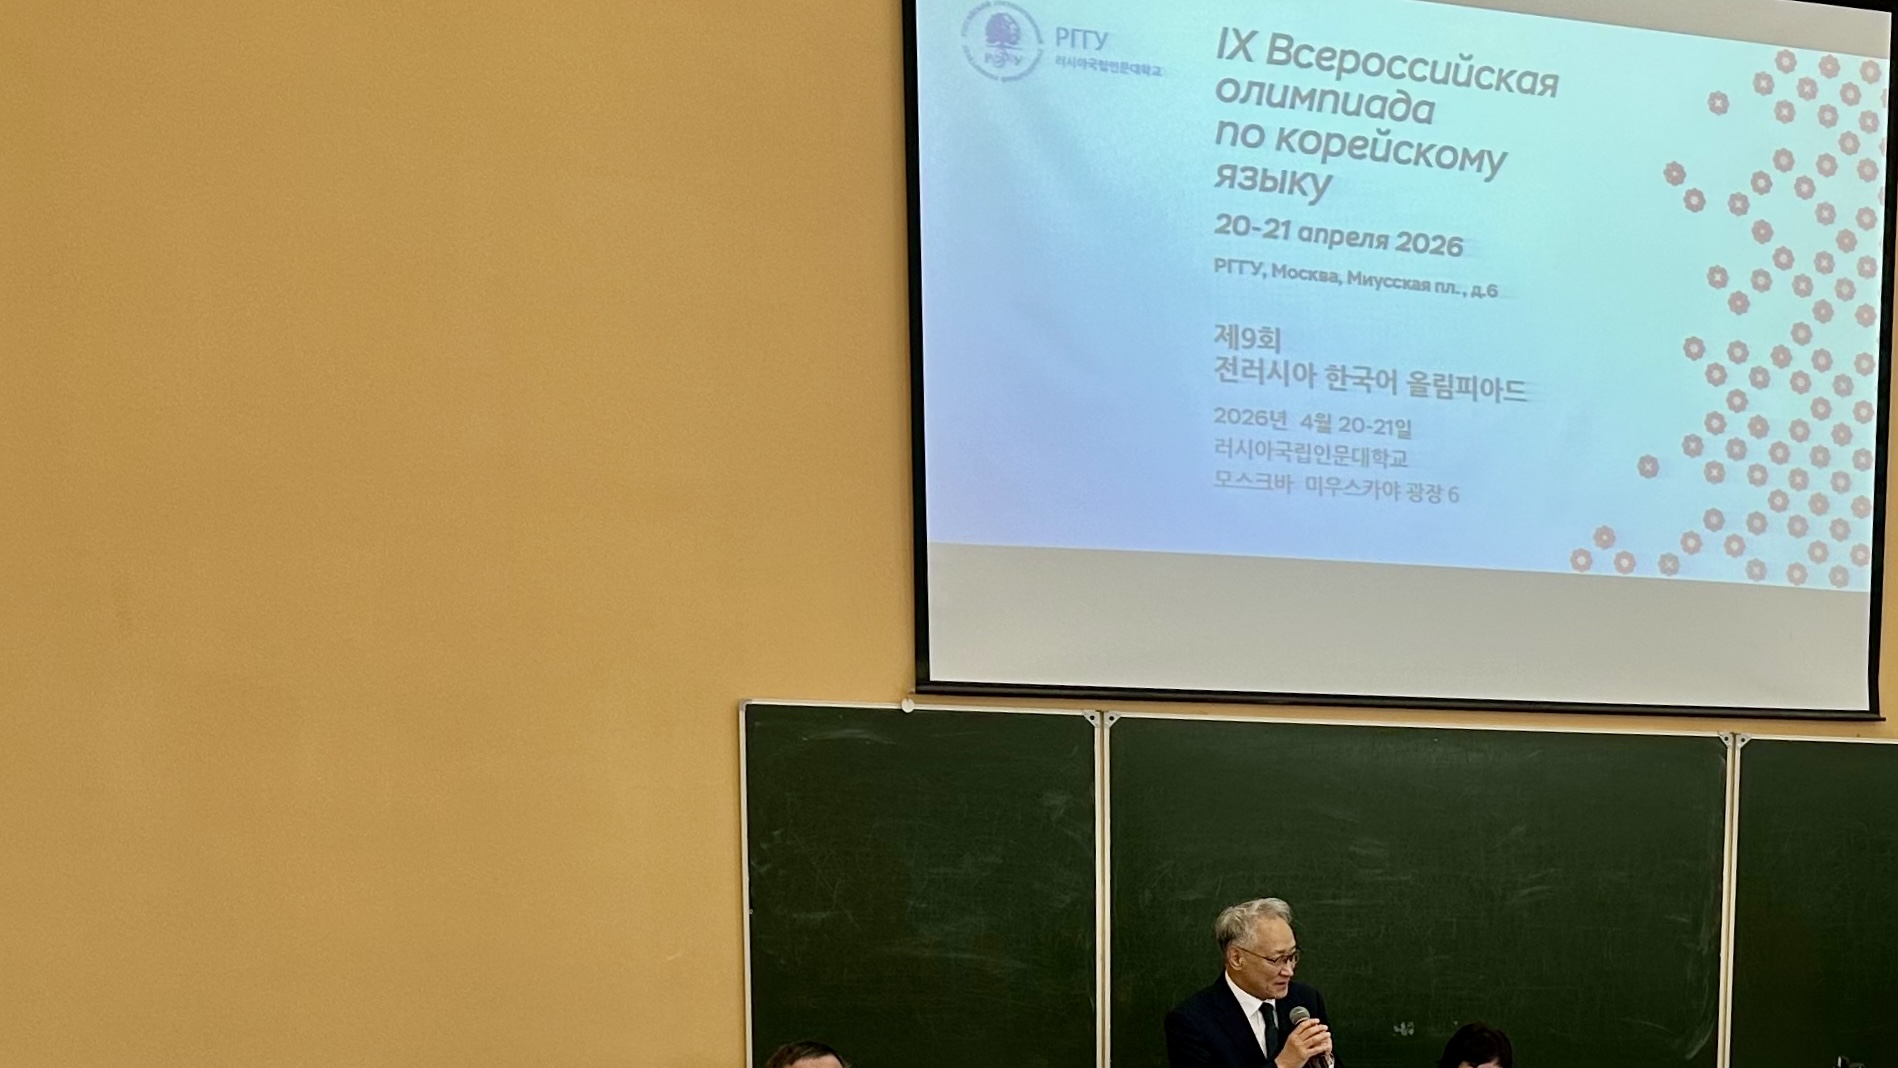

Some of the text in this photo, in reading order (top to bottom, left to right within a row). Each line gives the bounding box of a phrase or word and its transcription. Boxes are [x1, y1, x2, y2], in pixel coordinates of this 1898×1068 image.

[1056, 27, 1108, 50] РГГУ
[1216, 26, 1560, 98] IX Всероссийская
[1215, 77, 1435, 125] олимпиада
[1215, 120, 1509, 183] по корейскому
[1214, 163, 1334, 206] языку
[1214, 213, 1464, 257] 20-21 апреля 2026
[1214, 257, 1267, 279] РГГУ,
[1272, 263, 1342, 286] Москва,
[1347, 271, 1431, 293] Миусская
[1471, 283, 1499, 298] д.6
[1214, 324, 1281, 354] 제9회
[1215, 356, 1529, 403] 전러시아 한국어 올림피아드
[1214, 407, 1412, 440] 2026년 4월 20-21일
[1215, 438, 1408, 469] 러시아국립인문대학교
[1214, 470, 1460, 504] 모스크바 미우스카야 광장 6
